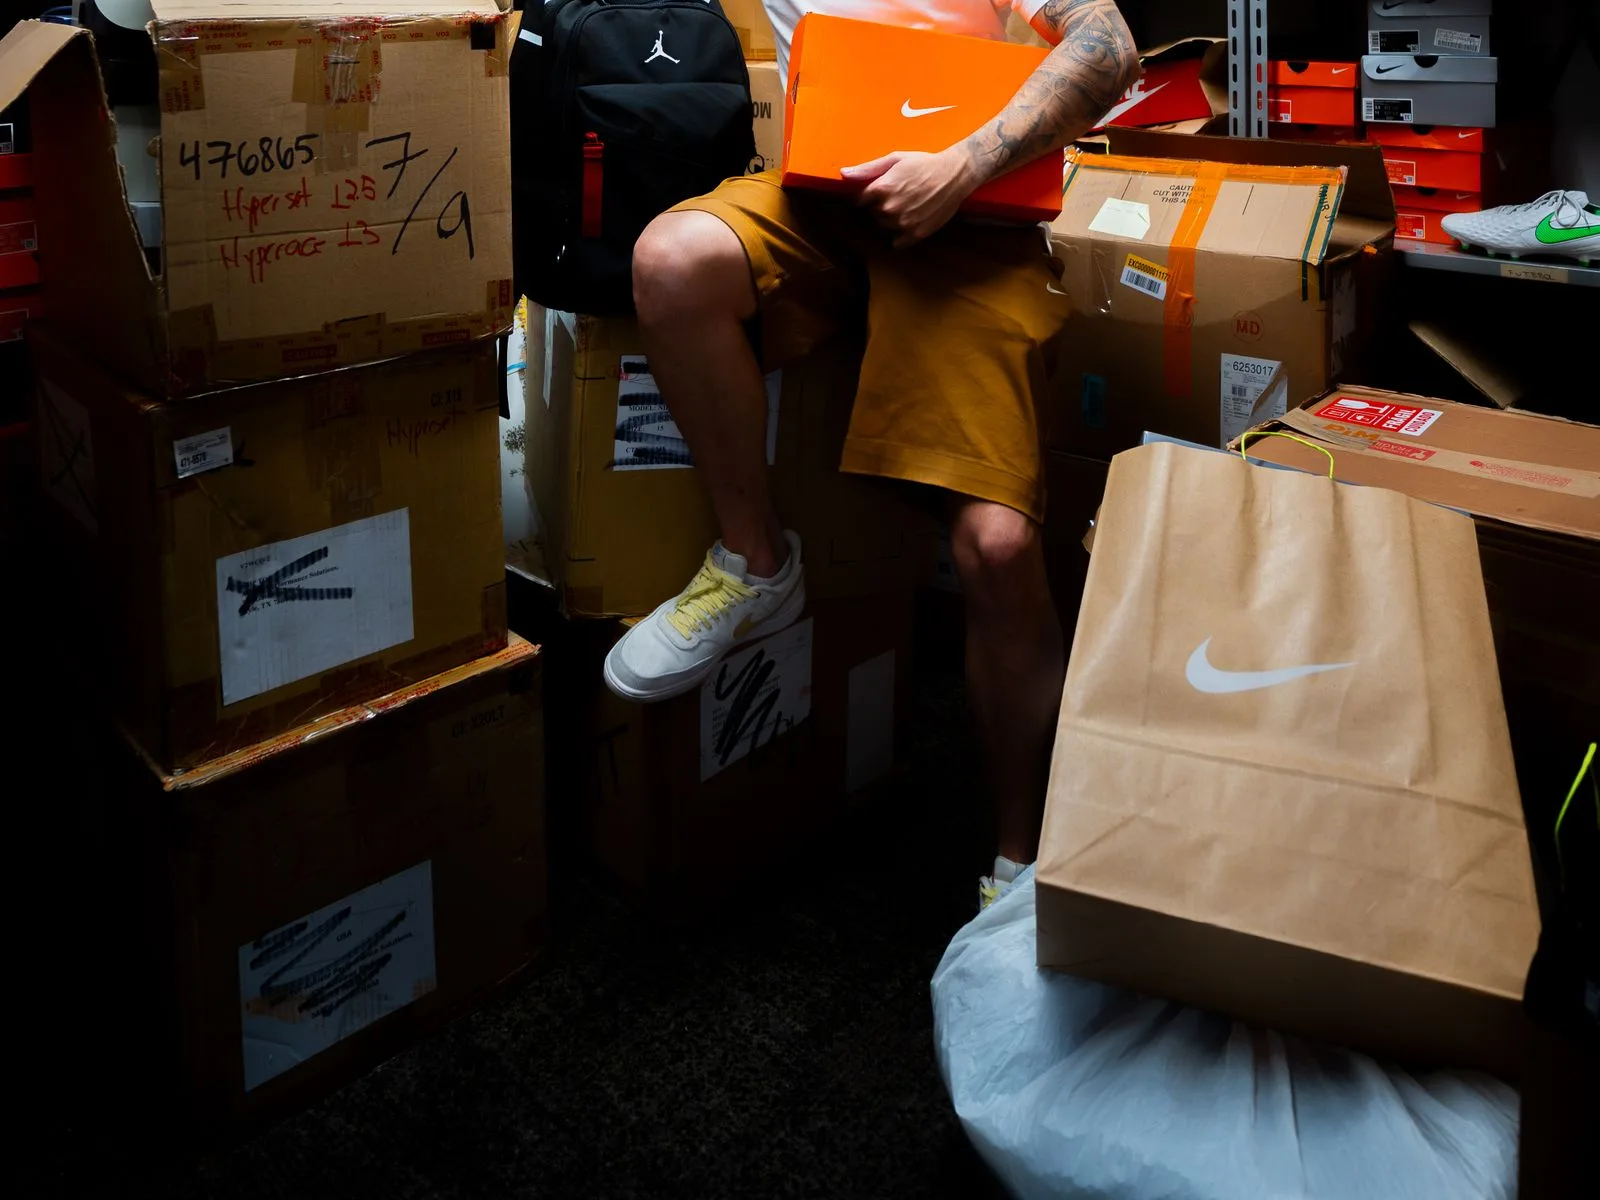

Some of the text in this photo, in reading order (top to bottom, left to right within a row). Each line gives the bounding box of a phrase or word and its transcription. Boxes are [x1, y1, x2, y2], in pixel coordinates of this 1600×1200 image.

[180, 133, 319, 180] 476865
[1236, 319, 1260, 335] MD
[1232, 361, 1273, 376] 6253017
[1382, 409, 1417, 429] FRÁGIL
[1405, 411, 1436, 432] CUIDADO
